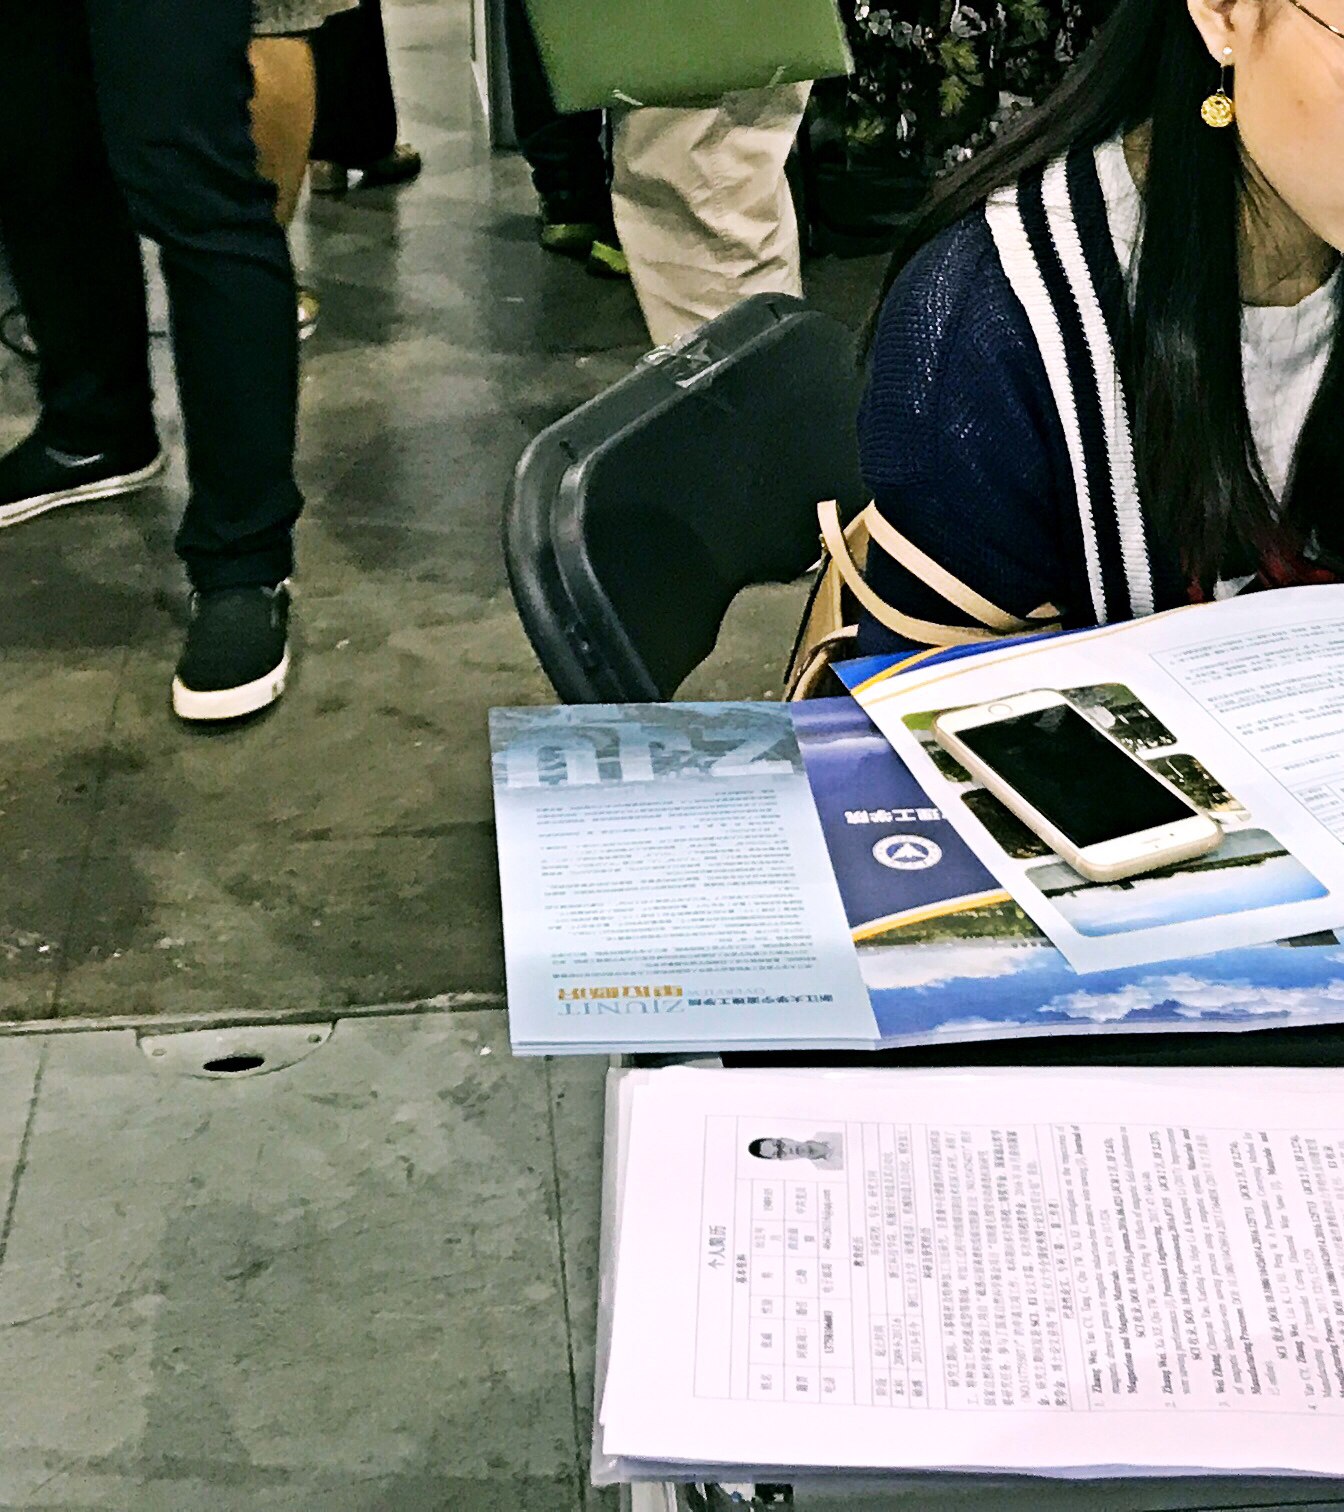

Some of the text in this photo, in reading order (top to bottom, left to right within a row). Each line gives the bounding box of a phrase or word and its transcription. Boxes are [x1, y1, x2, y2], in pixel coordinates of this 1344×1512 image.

[688, 993, 833, 1008] 浙江大学宁波理工学院
[707, 1224, 727, 1269] 个人简历
